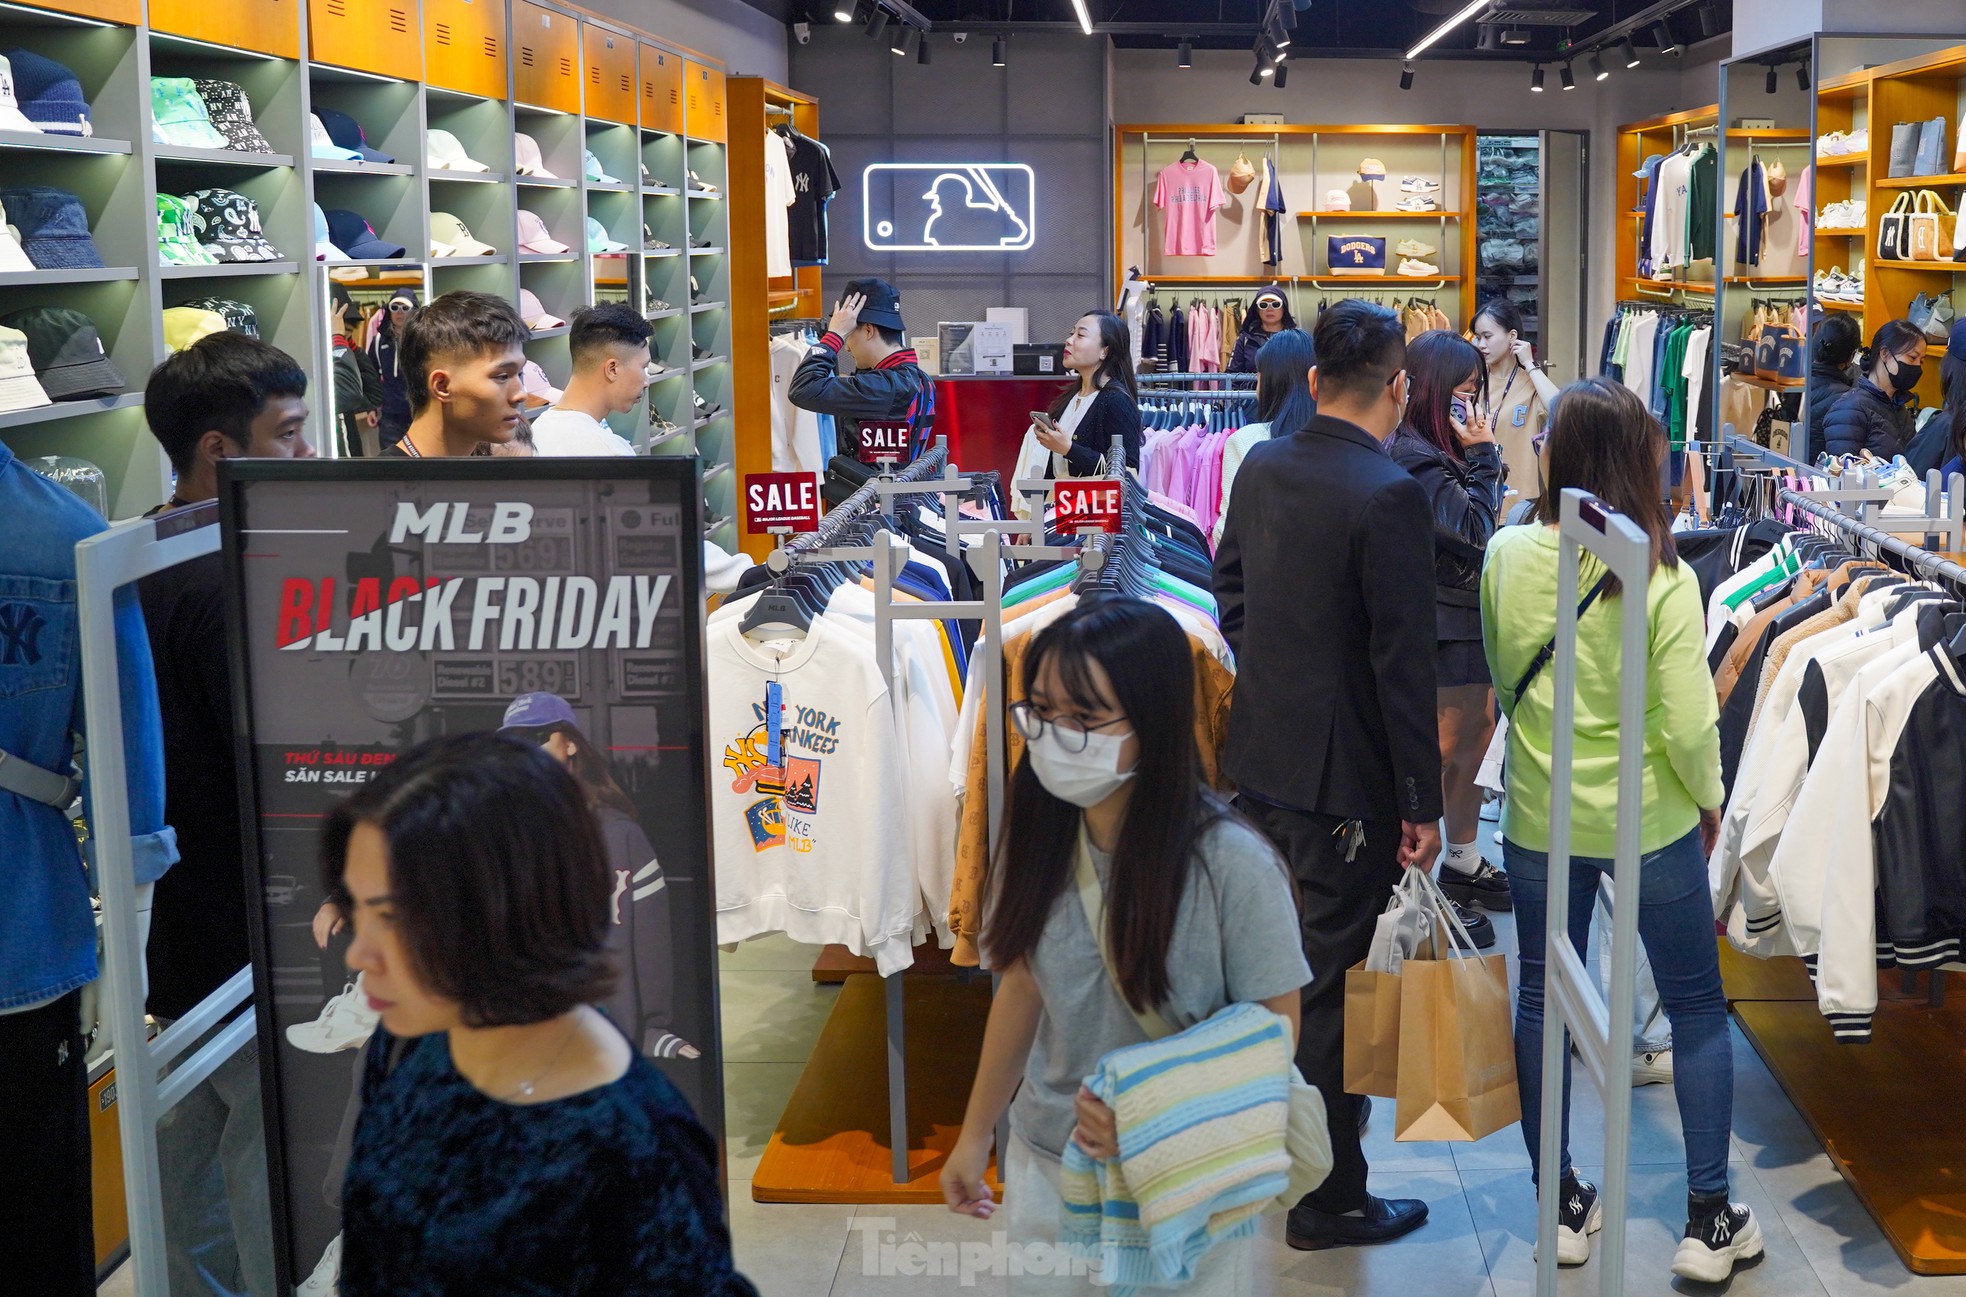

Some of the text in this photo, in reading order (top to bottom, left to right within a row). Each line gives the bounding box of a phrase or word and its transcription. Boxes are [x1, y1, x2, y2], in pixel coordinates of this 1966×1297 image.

[795, 172, 810, 193] NY
[1340, 241, 1376, 255] DODGERS
[1353, 250, 1365, 264] LA
[1511, 404, 1528, 428] C
[861, 427, 908, 447] SALE
[749, 482, 814, 512] SALE
[1058, 489, 1119, 515] SALE
[389, 502, 535, 544] MLB
[276, 575, 672, 652] BLACK FRIDAY
[795, 704, 841, 737] YORK
[284, 749, 321, 765] THỨ
[322, 747, 358, 765] SÁU
[284, 767, 321, 783] SĂN
[323, 771, 367, 783] SALE
[1568, 1194, 1583, 1216] NY
[1711, 1210, 1731, 1244] NY
